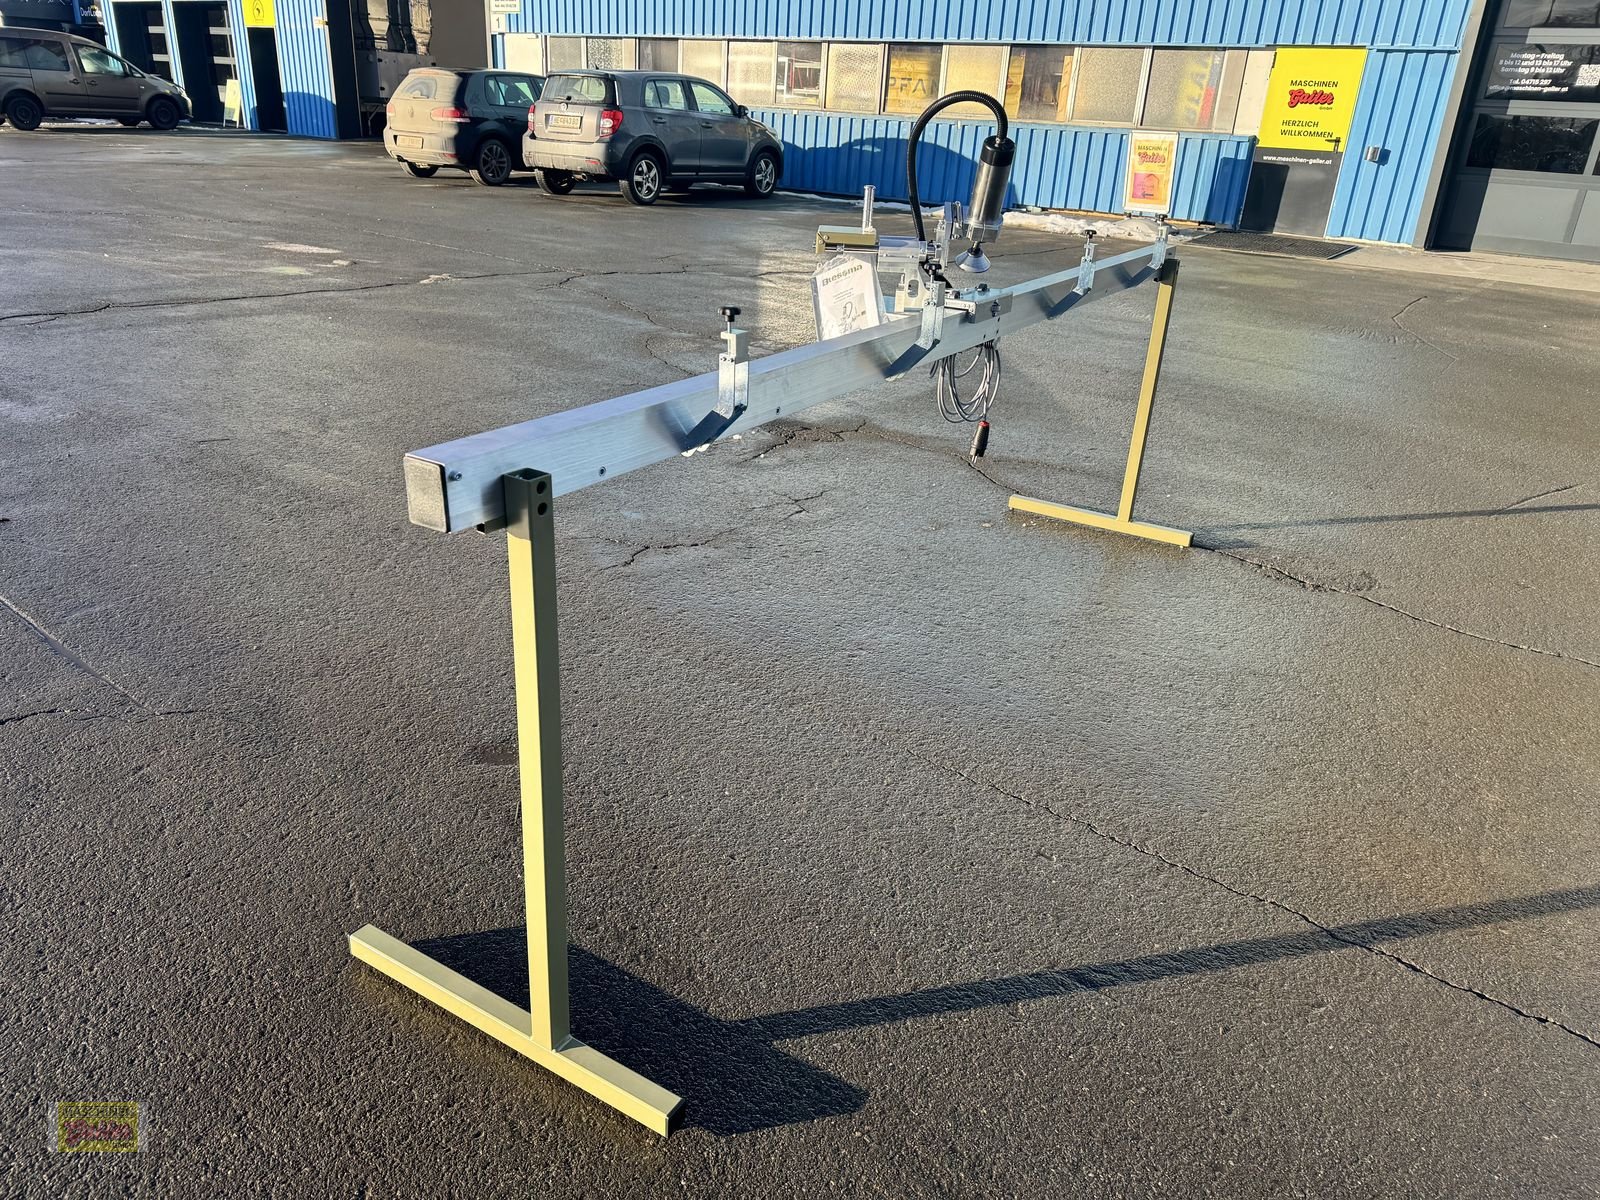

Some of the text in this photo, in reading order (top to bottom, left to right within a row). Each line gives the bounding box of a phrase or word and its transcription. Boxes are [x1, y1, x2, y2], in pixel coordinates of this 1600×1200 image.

[496, 17, 500, 29] 1
[1290, 80, 1338, 88] MASCHINEN
[1282, 119, 1319, 128] HERZLICH
[1280, 129, 1334, 138] WILLKOMMEN
[1263, 155, 1332, 164] www.maschinen-gailer.at
